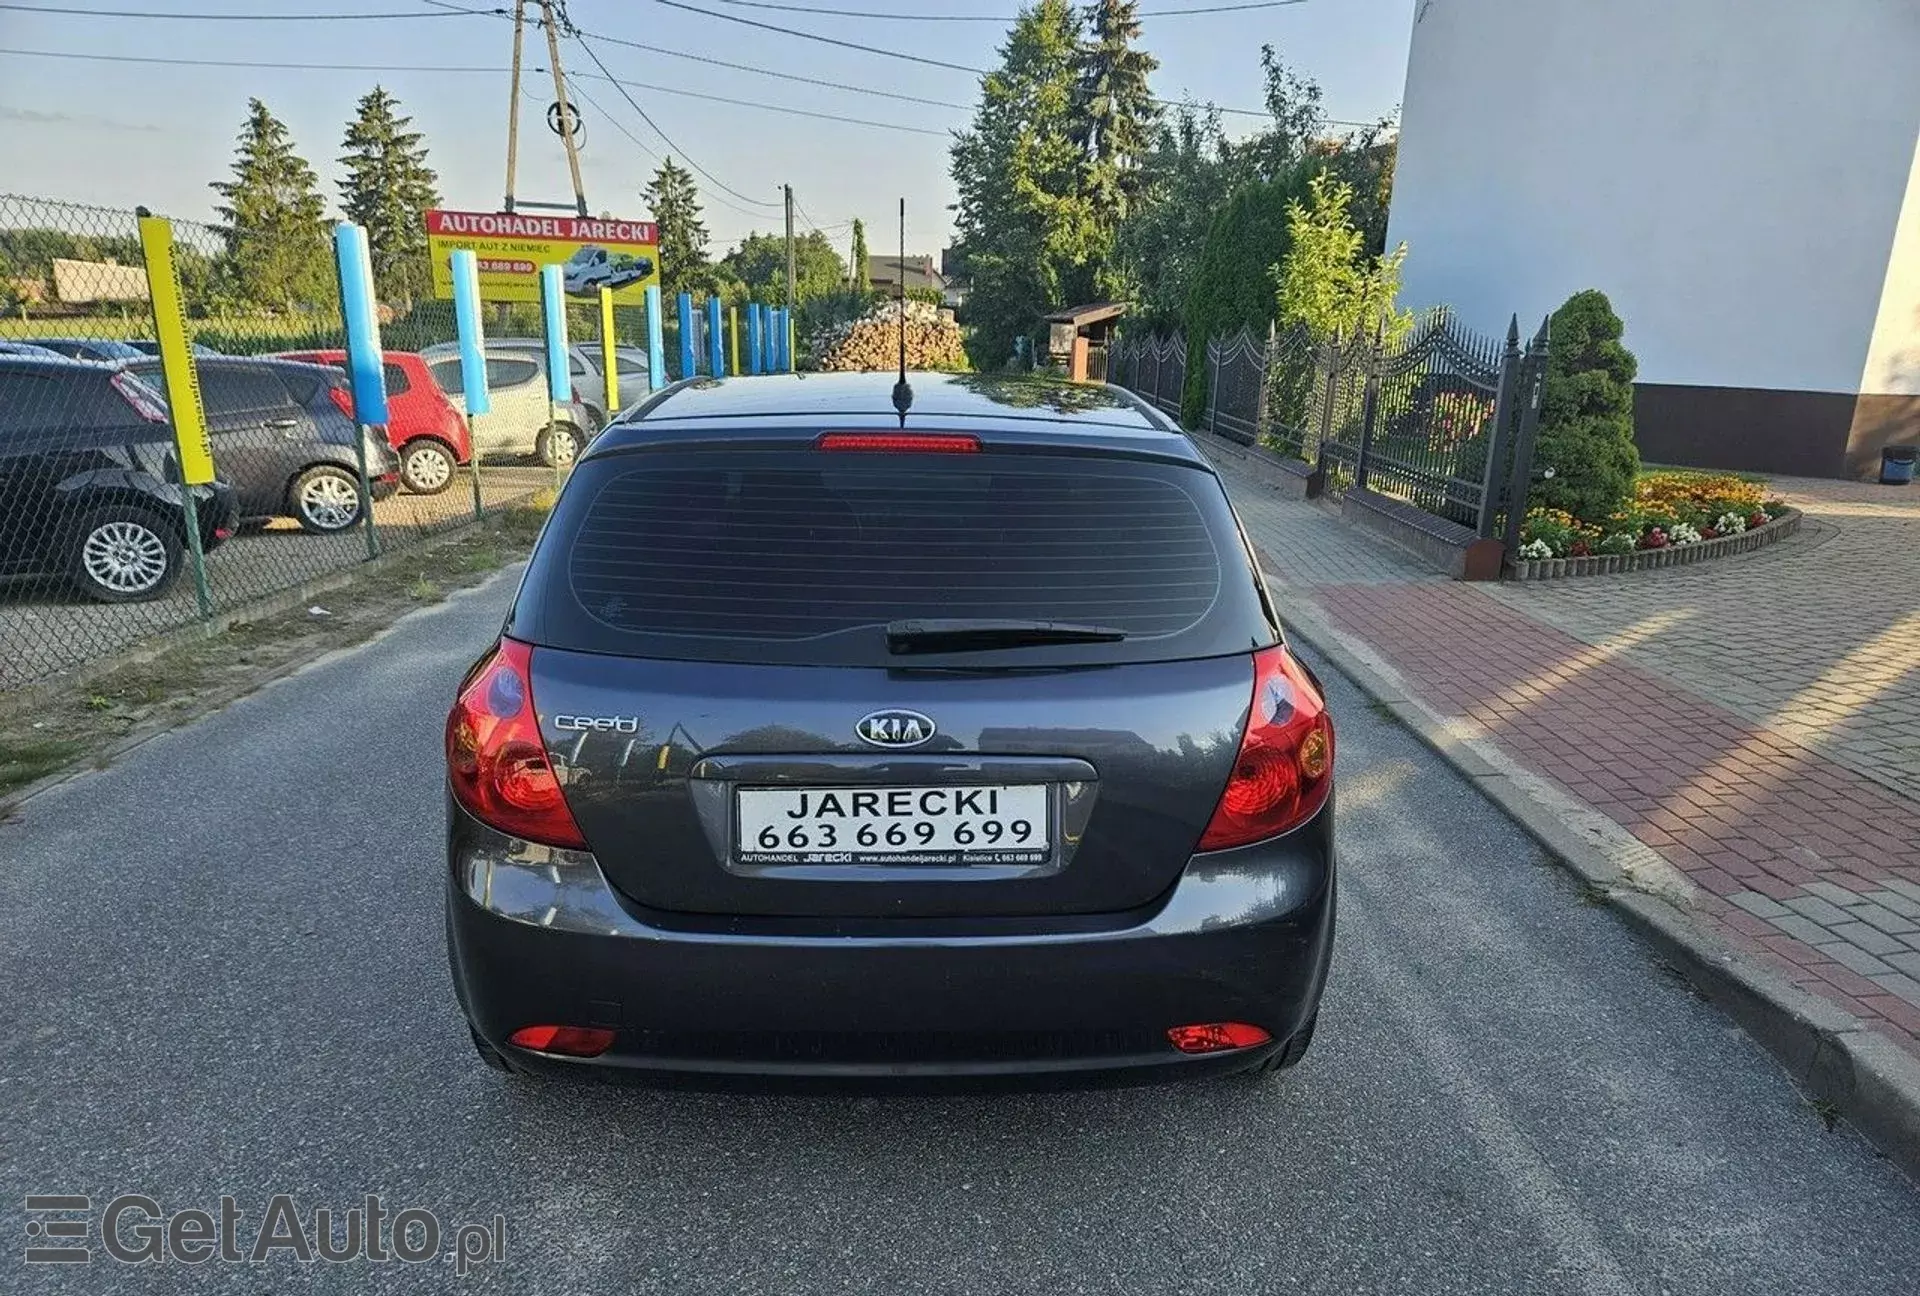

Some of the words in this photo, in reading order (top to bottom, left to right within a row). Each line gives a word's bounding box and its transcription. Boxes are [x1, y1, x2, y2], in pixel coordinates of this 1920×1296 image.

[439, 214, 564, 237] AUTOHADEL
[570, 220, 650, 242] JARECKI
[438, 241, 476, 250] IMPORT
[479, 242, 498, 251] AUT
[501, 243, 508, 251] Z
[510, 244, 551, 253] NIEMIEC
[869, 718, 924, 740] KIA
[787, 790, 998, 819] JARECKI
[758, 824, 837, 849] 663
[856, 822, 935, 846] 669
[954, 820, 1032, 844] 699
[741, 853, 798, 862] AUTOHANDEL
